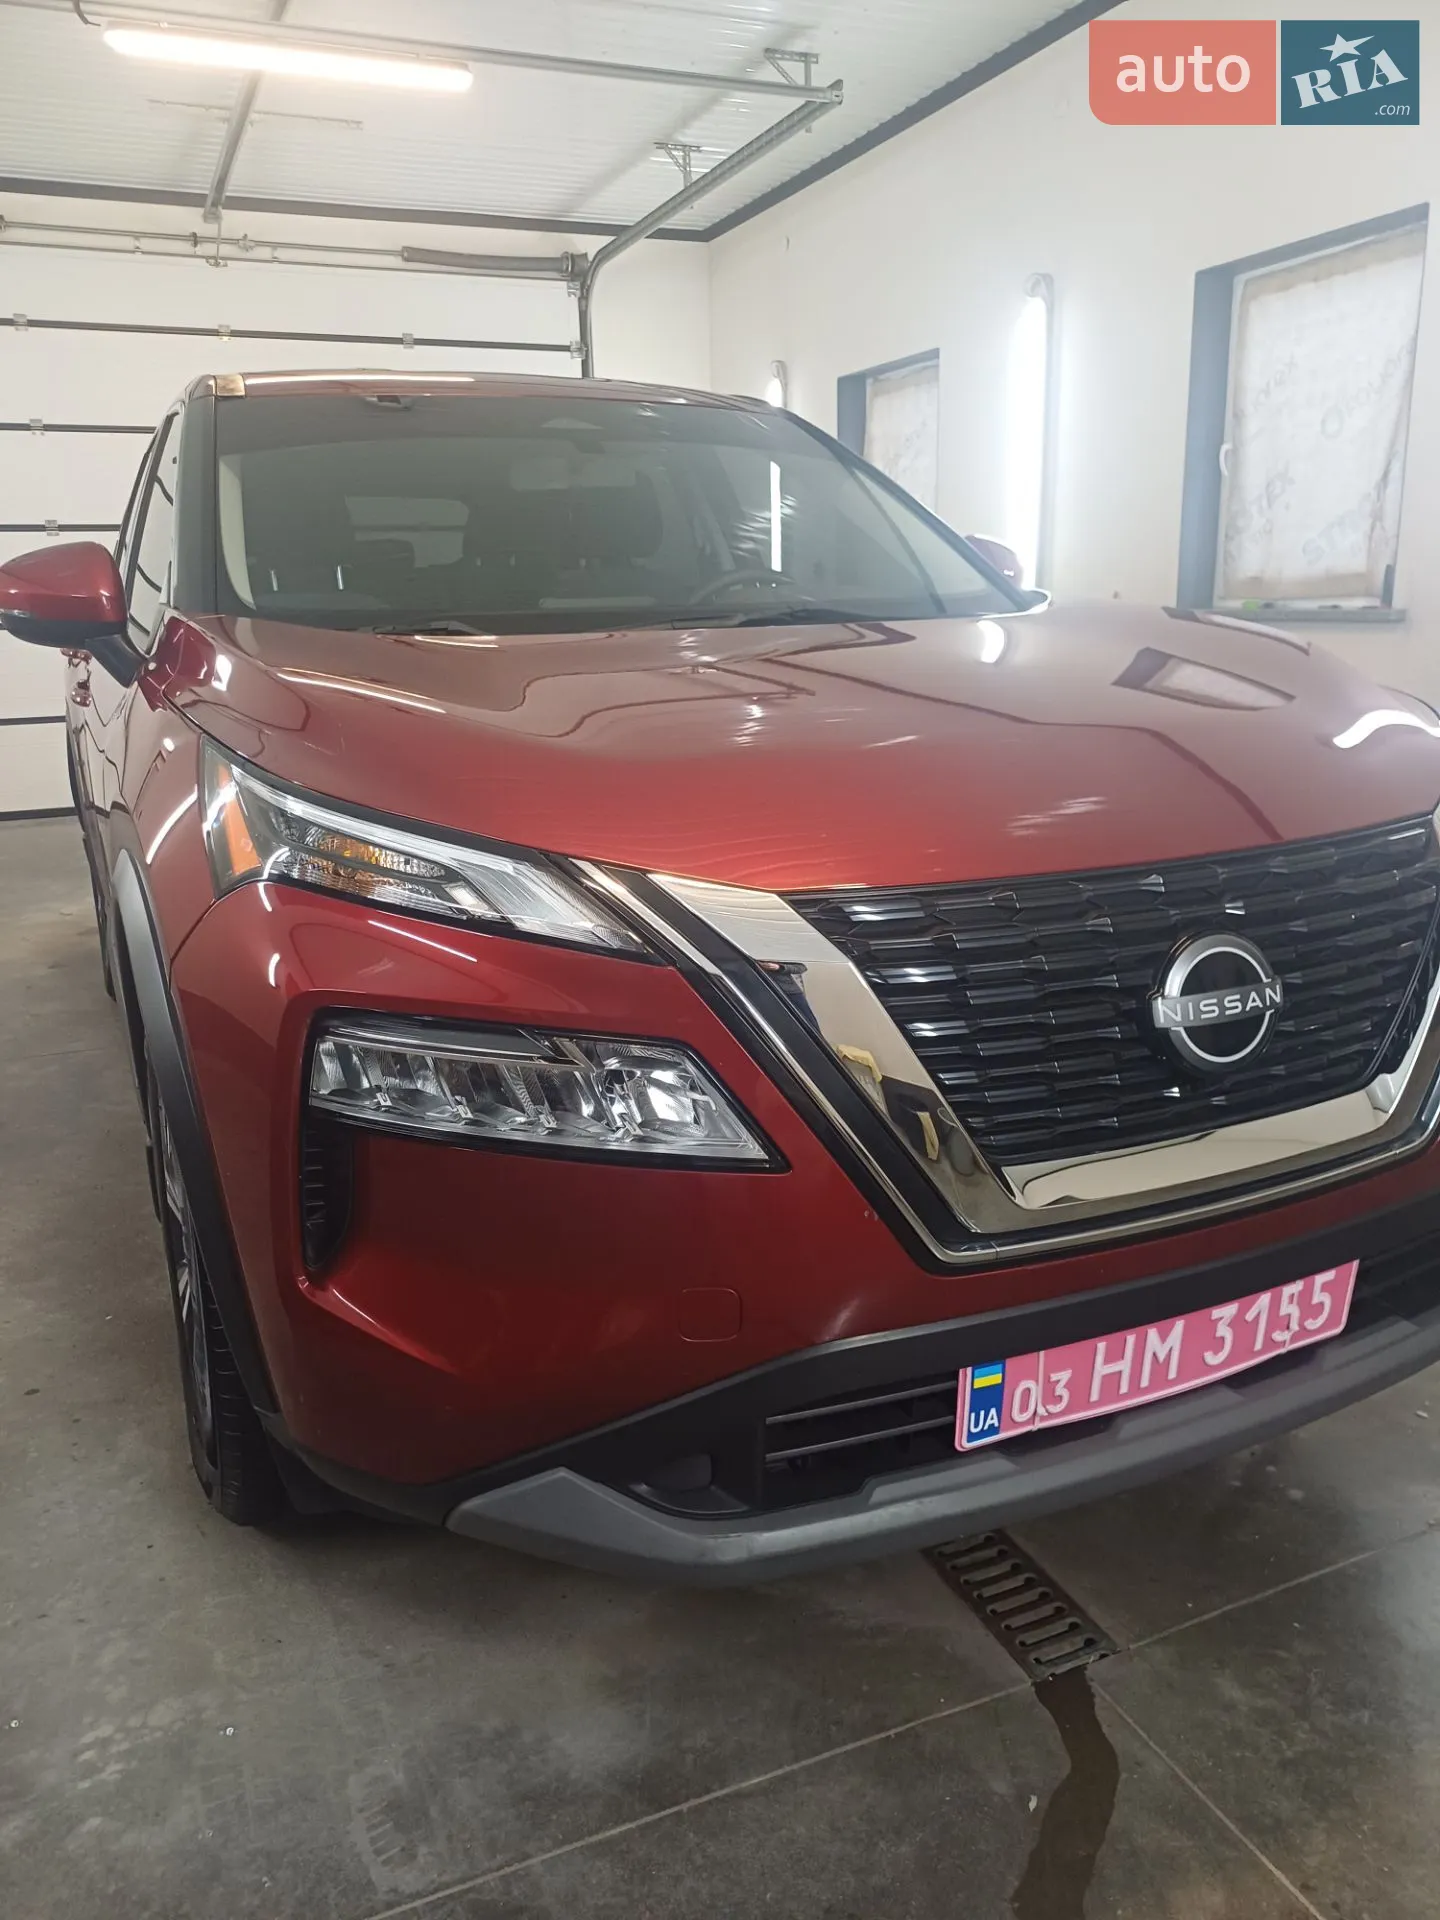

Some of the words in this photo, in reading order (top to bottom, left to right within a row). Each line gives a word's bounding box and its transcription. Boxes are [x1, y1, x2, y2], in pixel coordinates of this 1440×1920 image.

[1157, 984, 1282, 1024] NISSAN
[1011, 1369, 1073, 1423] 03
[1089, 1320, 1185, 1402] HM
[1203, 1269, 1337, 1366] 3155
[969, 1406, 999, 1433] UA
